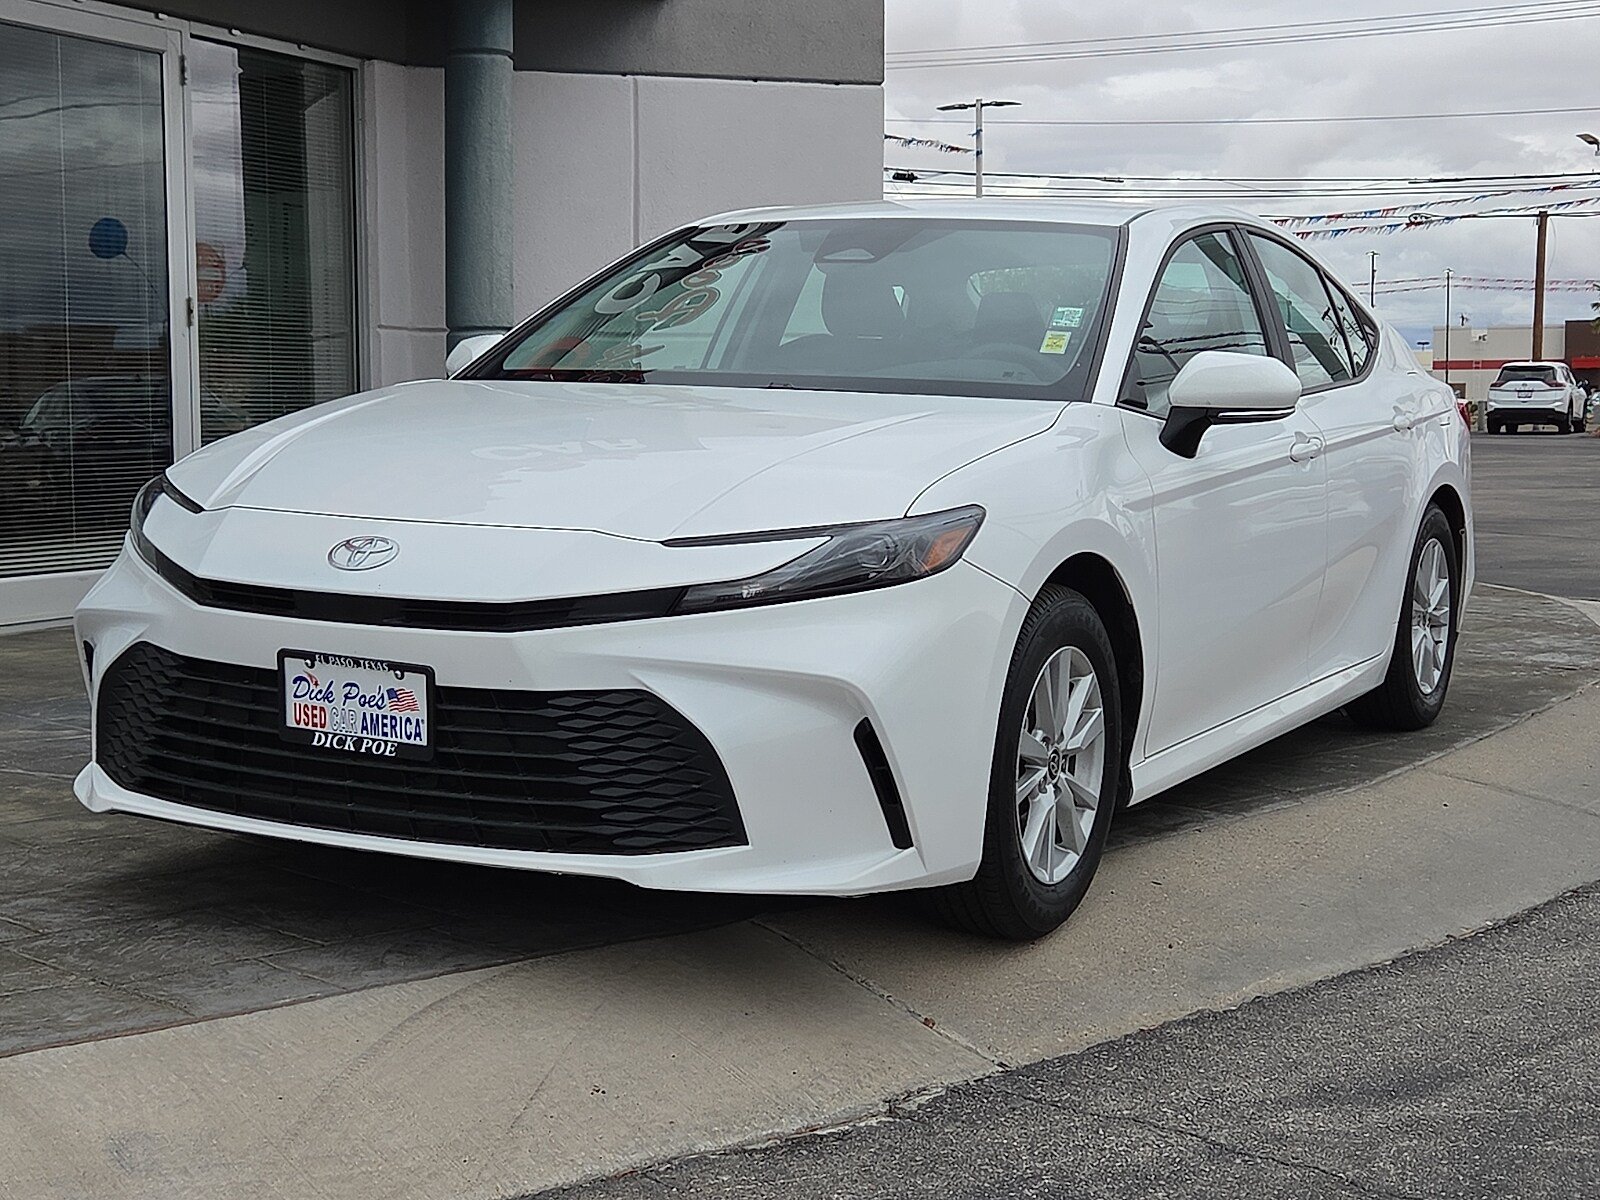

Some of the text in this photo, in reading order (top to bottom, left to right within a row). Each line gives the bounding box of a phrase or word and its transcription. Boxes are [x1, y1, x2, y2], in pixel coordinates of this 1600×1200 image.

[315, 654, 325, 665] EL
[359, 659, 389, 672] TEXAS
[292, 675, 387, 710] Dick Poe's
[293, 702, 423, 742] USED CAR AMERICA
[311, 732, 398, 757] DICK POE
